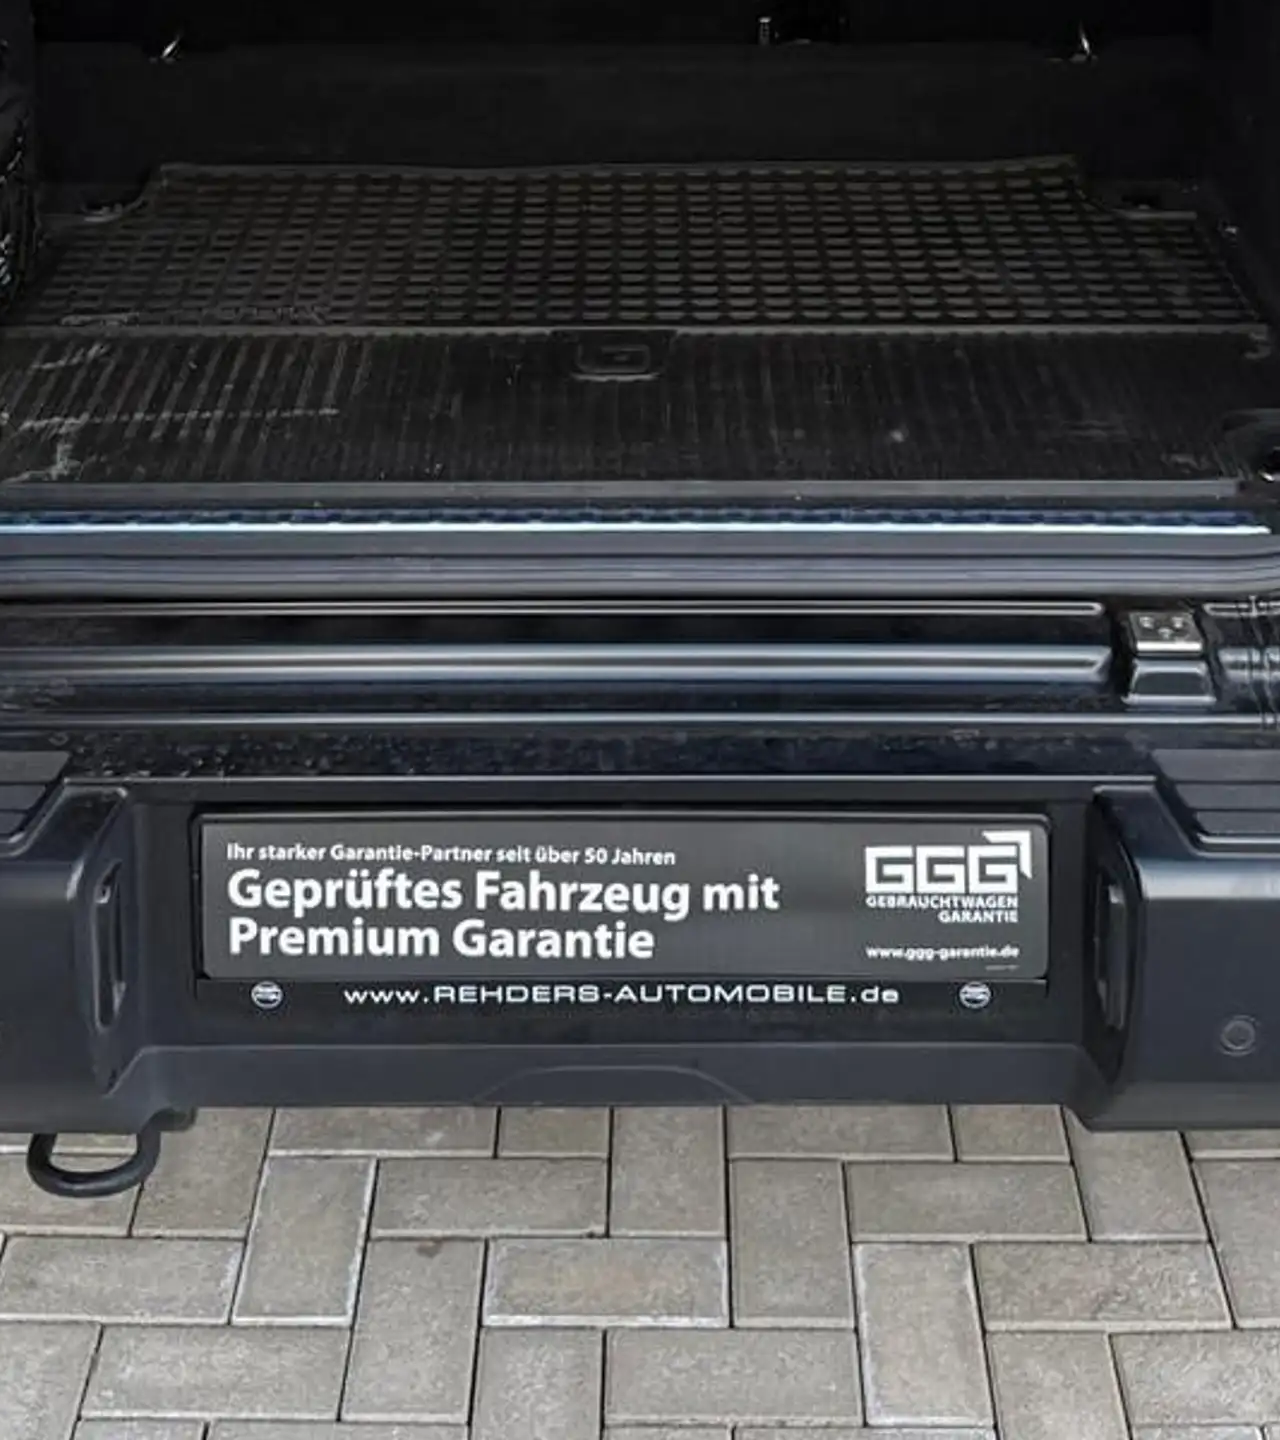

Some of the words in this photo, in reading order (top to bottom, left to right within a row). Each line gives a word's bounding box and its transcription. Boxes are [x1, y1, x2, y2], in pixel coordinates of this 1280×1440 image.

[227, 842, 255, 860] Ihr
[258, 843, 327, 861] starker
[329, 843, 493, 862] Garantie-Partner
[496, 845, 531, 863] seit
[534, 844, 580, 864] über
[584, 847, 608, 865] 50
[611, 847, 676, 865] Jahren
[864, 844, 1018, 894] GGG
[227, 867, 463, 918] Geprüftes
[475, 869, 690, 922] Fahrzeug
[703, 873, 780, 911] mit
[864, 895, 1018, 909] GEBRAUCHTWAGEN
[937, 909, 1018, 924] GARANTIE
[229, 916, 440, 956] Premium
[452, 918, 655, 958] Garantie
[865, 944, 1020, 961] www.ggg-garantie.de
[344, 983, 899, 1004] www.REHDERS-AUTOMOBILE.de
